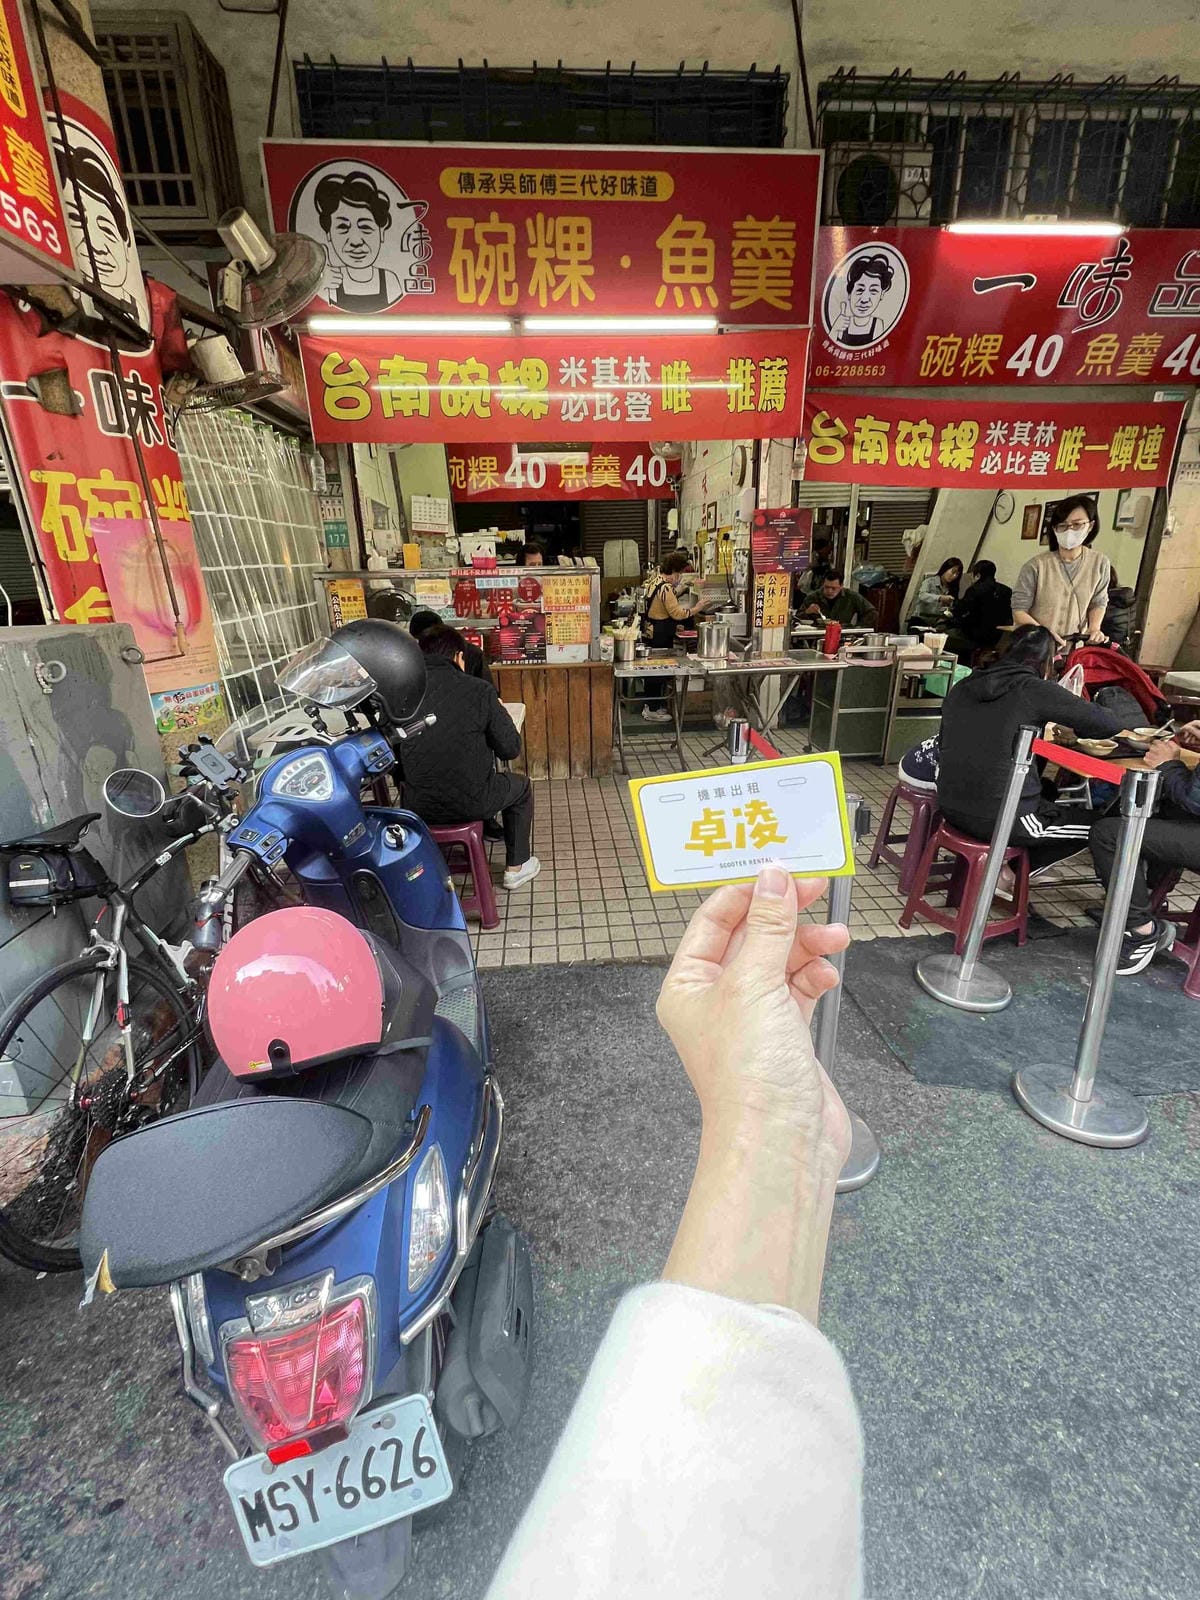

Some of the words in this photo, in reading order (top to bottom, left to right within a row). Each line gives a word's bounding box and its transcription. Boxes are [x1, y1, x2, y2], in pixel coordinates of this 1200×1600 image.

[457, 171, 658, 197] 傳承吳師傅三代好味道
[815, 365, 886, 377] 06-2288563
[919, 333, 1004, 378] 碗粿
[1006, 334, 1064, 378] 40
[1076, 332, 1165, 377] 魚羹
[320, 352, 549, 421] 台南碗粿
[661, 357, 789, 413] 唯一推薦
[560, 389, 653, 423] 必比登
[808, 410, 981, 472] 台南碗粿
[985, 421, 1057, 447] 米其林
[504, 455, 547, 489] 40
[558, 454, 622, 488] 魚羹
[625, 454, 668, 488] 40
[980, 450, 1051, 476] 必比登
[328, 533, 346, 544] 177
[698, 782, 761, 801] 機車出租
[684, 799, 788, 857] 卓凌
[719, 859, 747, 869] SCOOTER
[749, 857, 773, 866] RENTAL
[238, 1425, 437, 1542] MSY-6626
